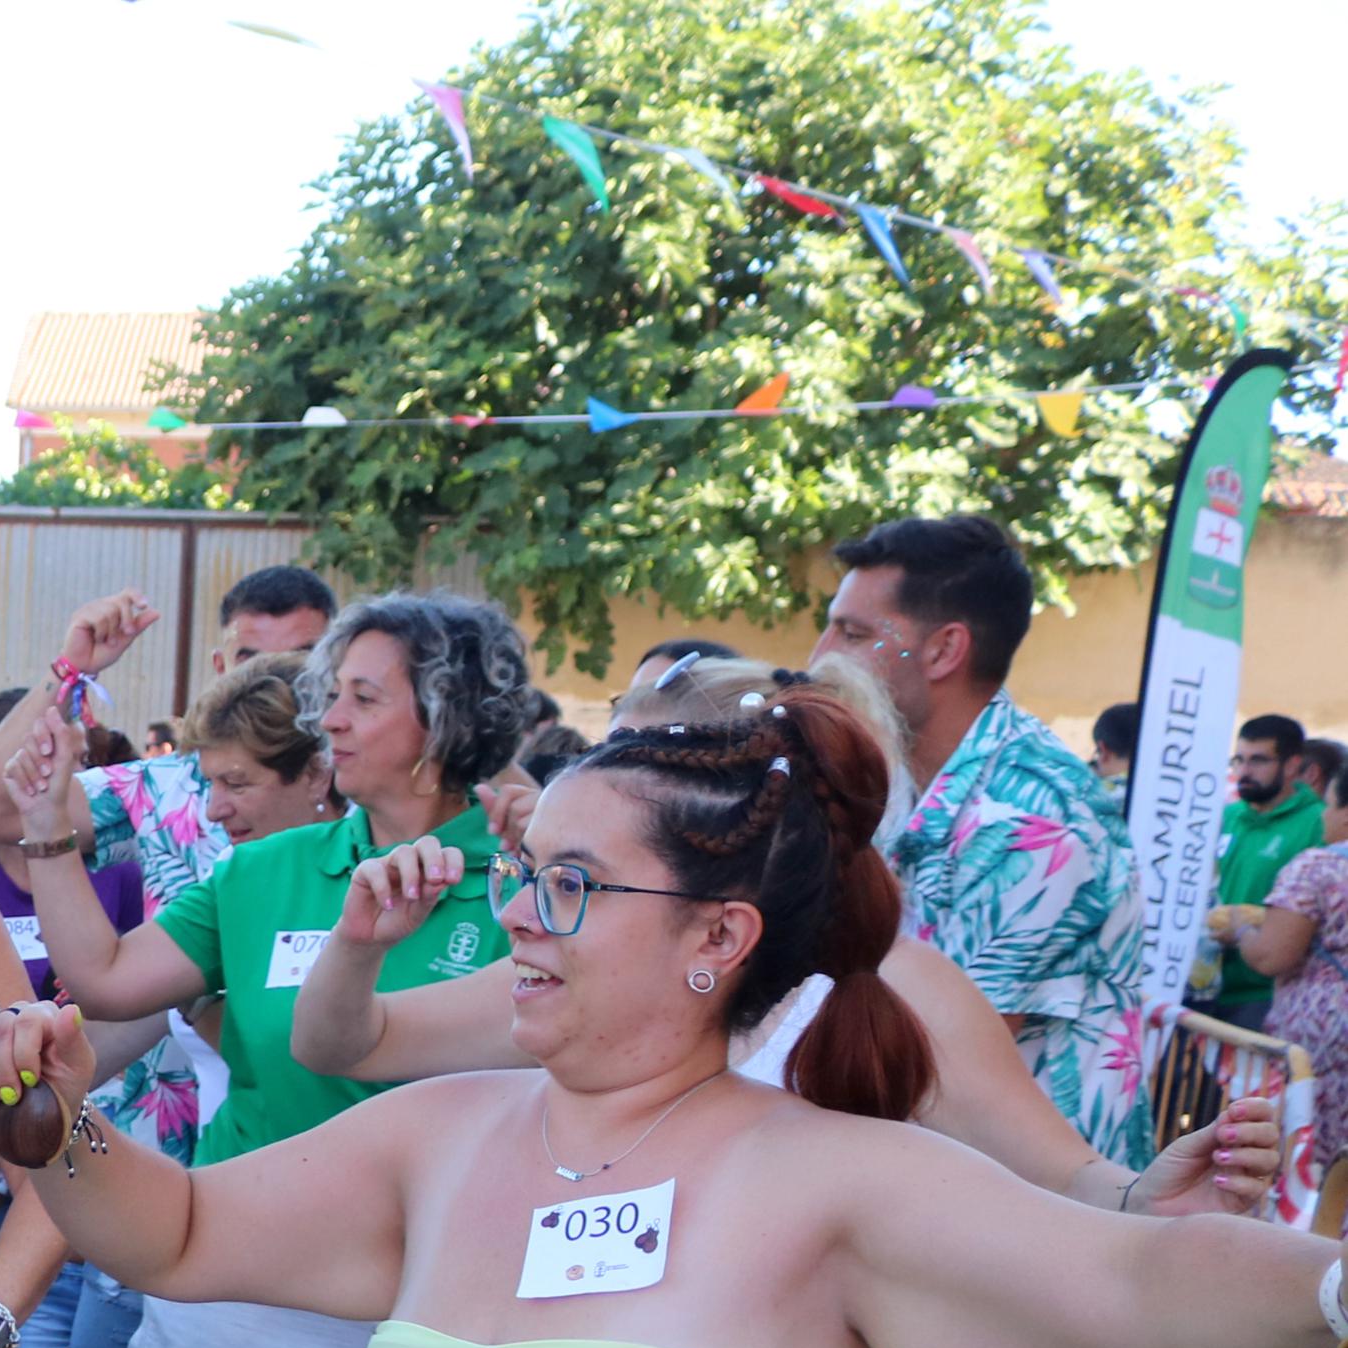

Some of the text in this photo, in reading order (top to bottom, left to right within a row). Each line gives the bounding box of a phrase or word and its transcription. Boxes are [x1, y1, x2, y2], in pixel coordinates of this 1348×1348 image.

[1162, 771, 1217, 989] DE CERRATO
[564, 1202, 639, 1241] 030
